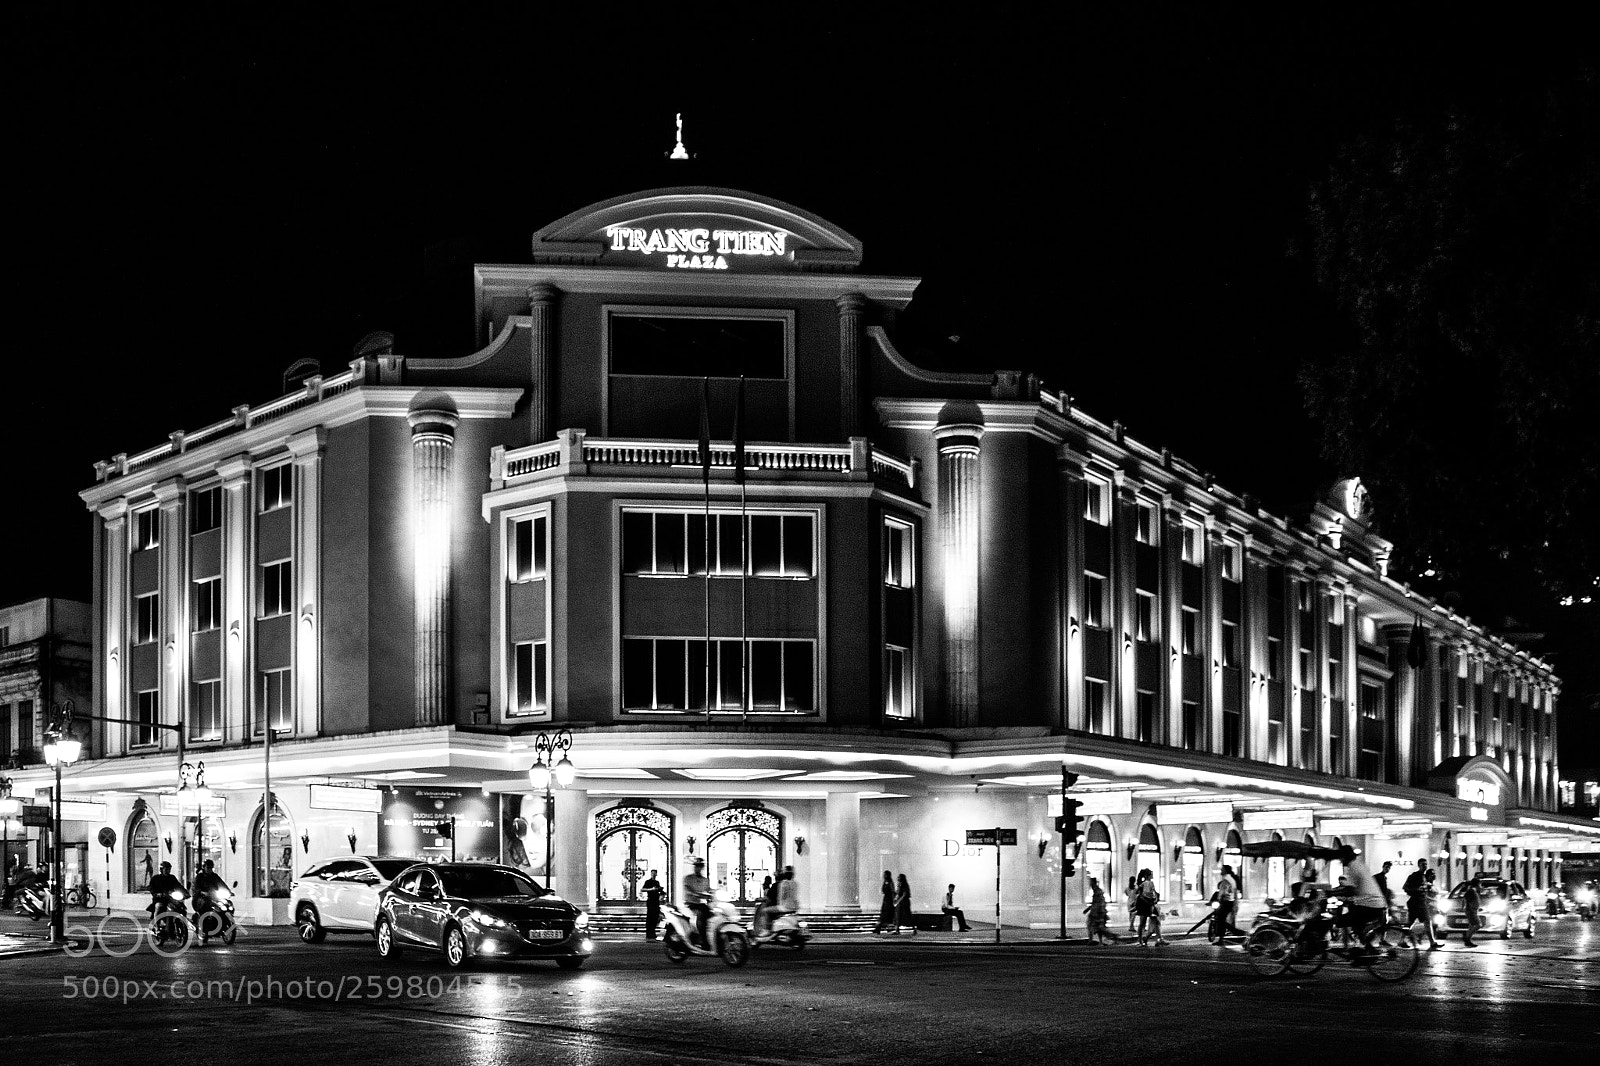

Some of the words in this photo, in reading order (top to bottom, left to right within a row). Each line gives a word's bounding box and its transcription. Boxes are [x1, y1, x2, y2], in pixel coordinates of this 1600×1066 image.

[606, 227, 710, 254] TRANG
[712, 229, 787, 256] TIEN
[666, 253, 729, 270] PLAZA
[942, 838, 984, 857] Dior
